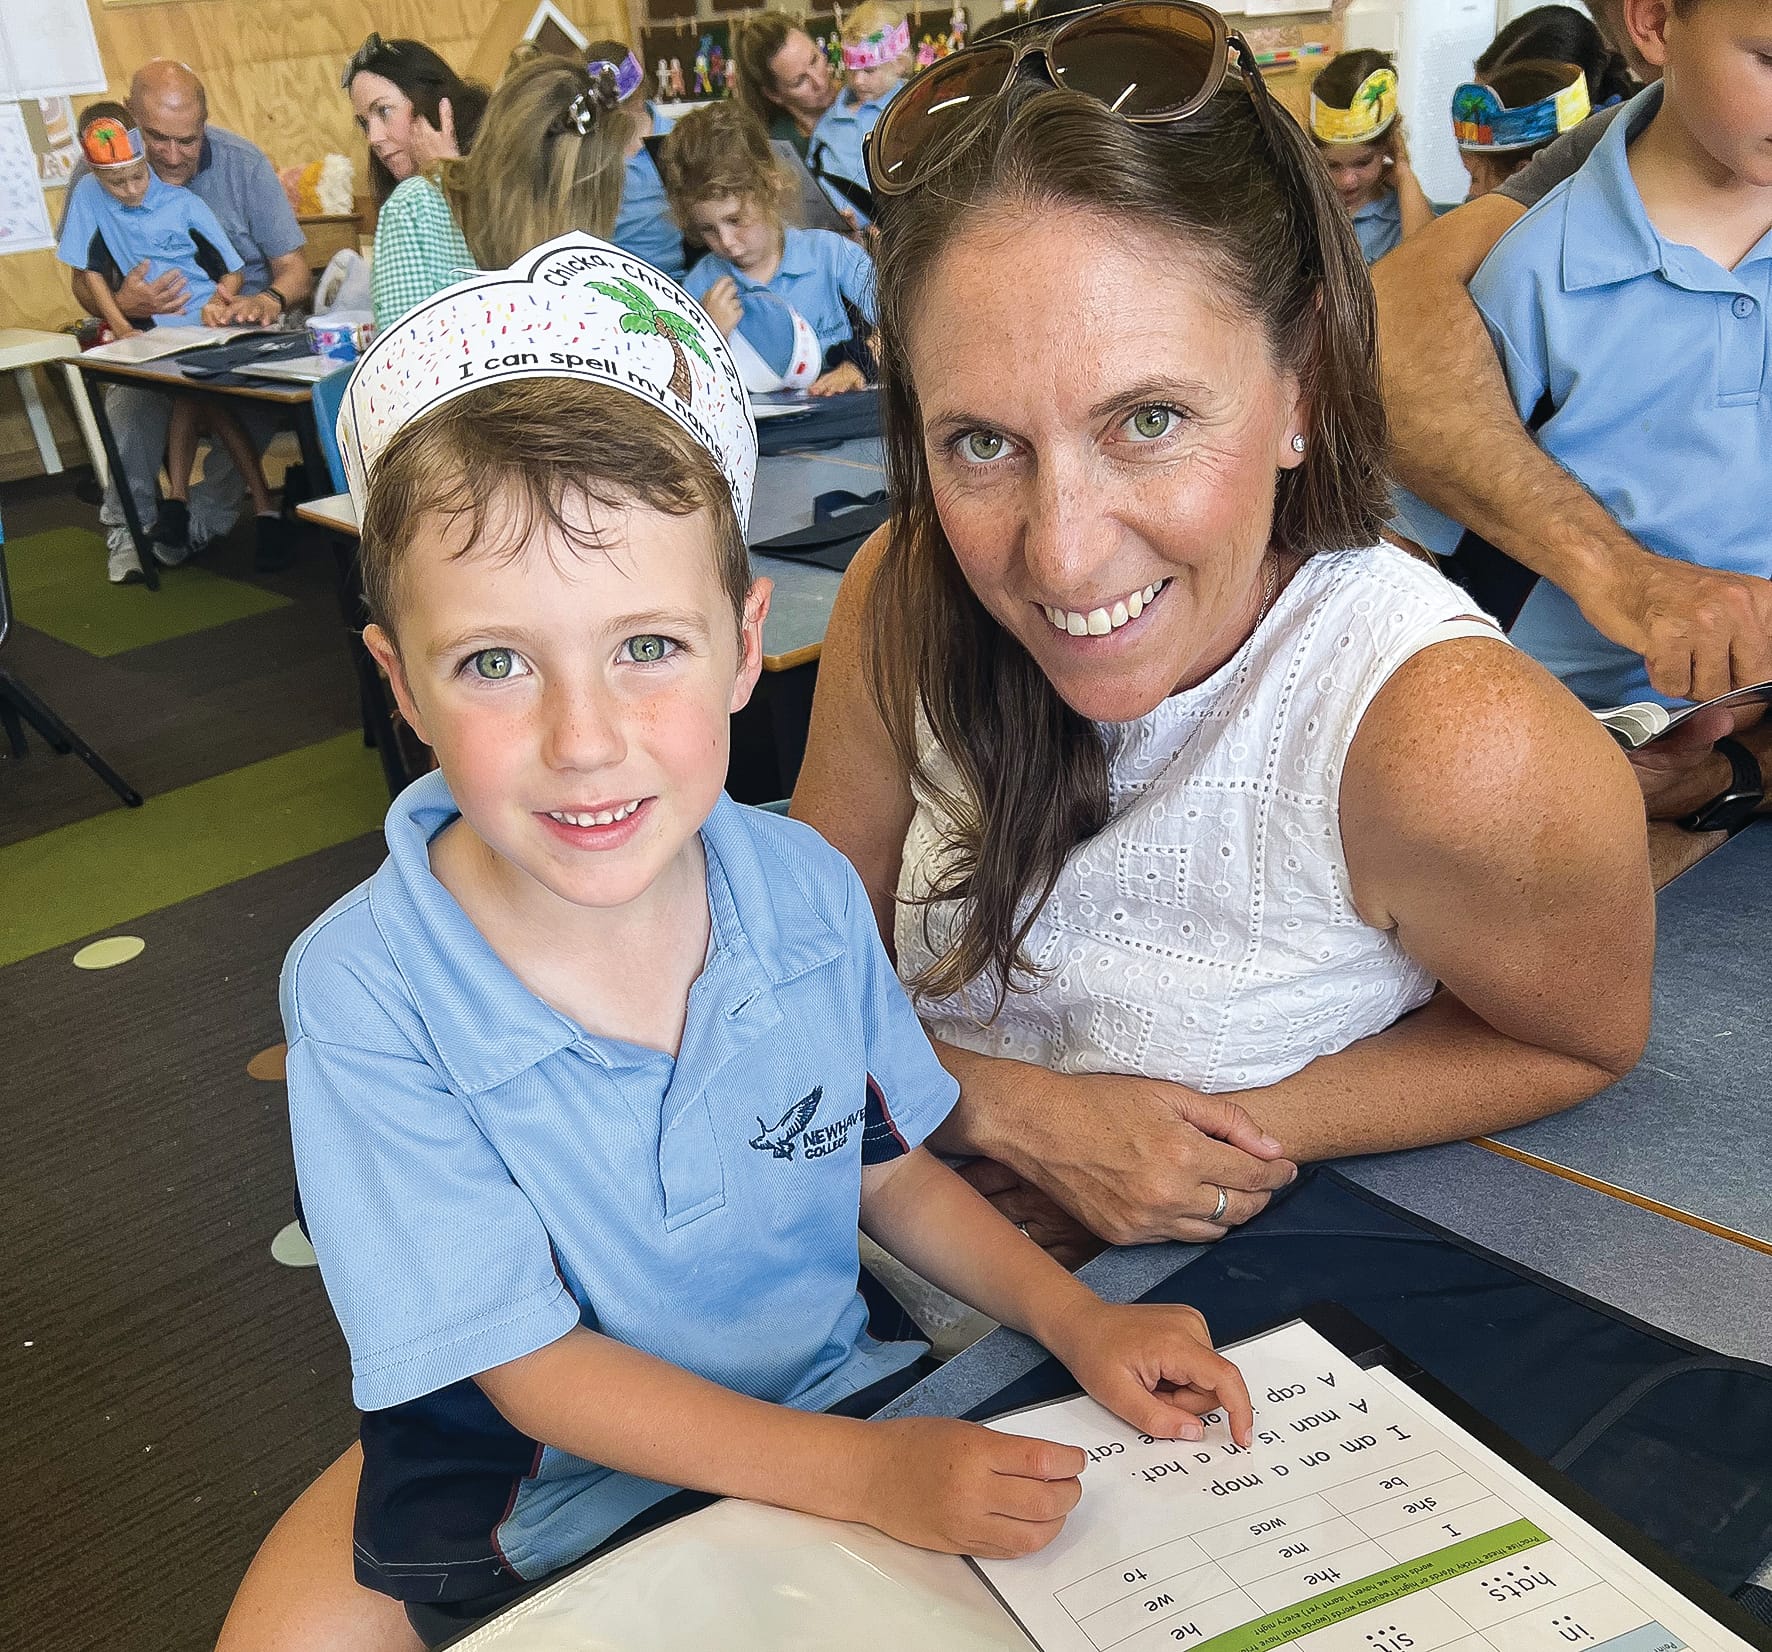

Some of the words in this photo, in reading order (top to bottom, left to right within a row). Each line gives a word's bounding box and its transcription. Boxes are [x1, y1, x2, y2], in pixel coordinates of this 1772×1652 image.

[543, 254, 615, 287] Chicka,
[459, 361, 474, 380] I
[484, 352, 539, 371] can
[550, 352, 618, 376] spell
[627, 371, 665, 402] my
[803, 1108, 866, 1149] NEWHAVE
[805, 1133, 849, 1160] COLLEGE
[1316, 1371, 1336, 1388] A
[1266, 1383, 1306, 1403] cap
[1348, 1398, 1368, 1414] A
[1289, 1409, 1341, 1432] man
[1257, 1430, 1286, 1445] is
[1386, 1424, 1411, 1441] I
[1339, 1434, 1377, 1453] am
[1192, 1452, 1211, 1464] a
[1298, 1451, 1331, 1467] on
[1131, 1460, 1190, 1483] hat.
[1270, 1465, 1290, 1476] a
[1202, 1473, 1264, 1496] mop.
[1378, 1476, 1409, 1490] be
[1402, 1496, 1437, 1514] she
[1249, 1517, 1287, 1536] was
[1441, 1523, 1462, 1538] I
[1278, 1542, 1310, 1558] me
[1507, 1535, 1539, 1551] Practise
[1482, 1548, 1507, 1560] these
[1408, 1562, 1434, 1575] words
[1455, 1557, 1485, 1570] Tricky
[1123, 1568, 1148, 1583] to
[1303, 1567, 1341, 1586] the
[1390, 1572, 1410, 1584] that
[1419, 1576, 1429, 1585] or
[1429, 1567, 1457, 1581] Words
[1348, 1584, 1379, 1599] haven't
[1376, 1579, 1391, 1588] we
[1488, 1570, 1557, 1602] hats
[1143, 1593, 1175, 1612] we
[1321, 1595, 1349, 1609] learnt
[1357, 1582, 1420, 1607] high-frequency
[1300, 1603, 1321, 1617] yet)
[1330, 1605, 1357, 1618] words
[1276, 1611, 1302, 1626] every
[1300, 1614, 1331, 1630] (words
[1170, 1622, 1203, 1641] he
[1282, 1627, 1302, 1639] that
[1558, 1623, 1595, 1642] in
[1259, 1634, 1282, 1647] have
